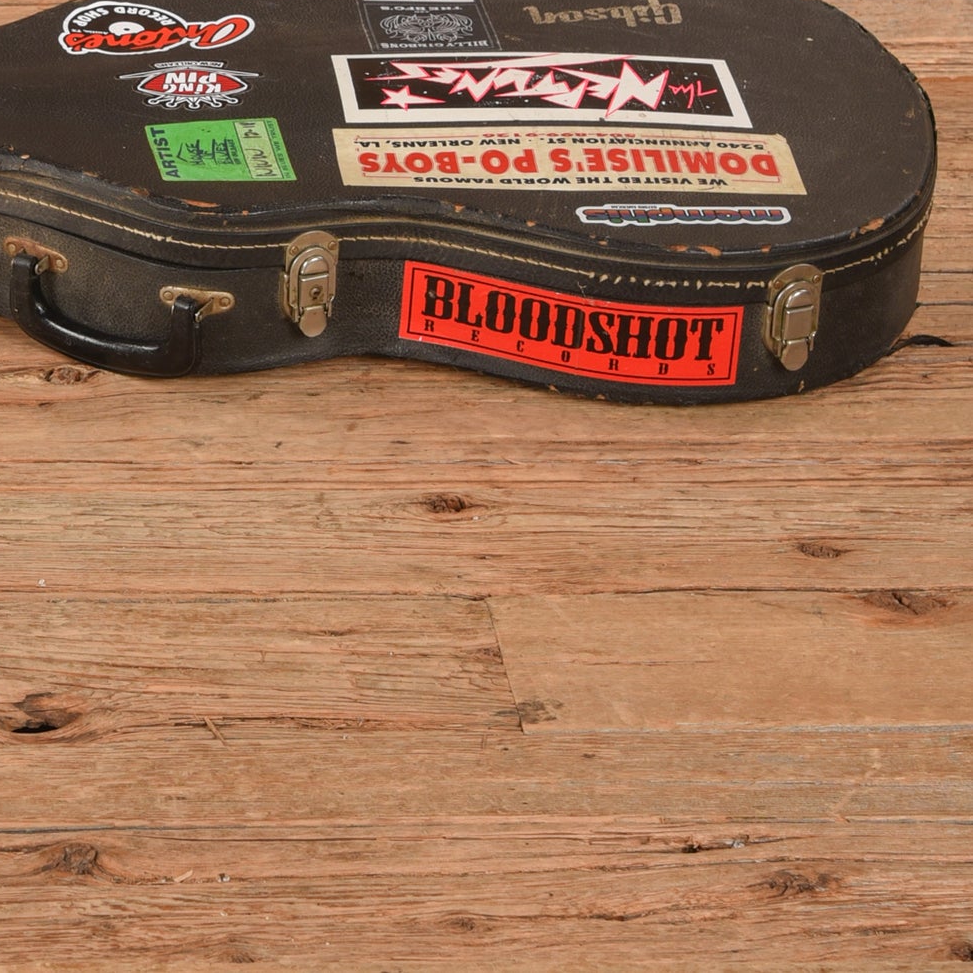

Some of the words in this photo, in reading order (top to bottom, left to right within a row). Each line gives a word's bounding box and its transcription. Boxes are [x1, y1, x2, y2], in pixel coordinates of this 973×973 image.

[72, 8, 109, 27] SHOP
[113, 7, 176, 26] RECORD
[65, 18, 248, 52] Antone's
[165, 72, 217, 84] PIN
[385, 140, 474, 148] ORLEANS,
[479, 138, 522, 146] NEW
[571, 137, 712, 148] ANNUNCIATION
[716, 142, 764, 150] 5240
[150, 127, 181, 178] ARTIST
[357, 149, 539, 175] PO-BOYS
[548, 148, 780, 177] DOMILISE'S
[618, 177, 693, 185] VISITED
[697, 178, 729, 186] WE
[583, 207, 784, 225] memphis
[420, 274, 724, 362] BLOODSHOT
